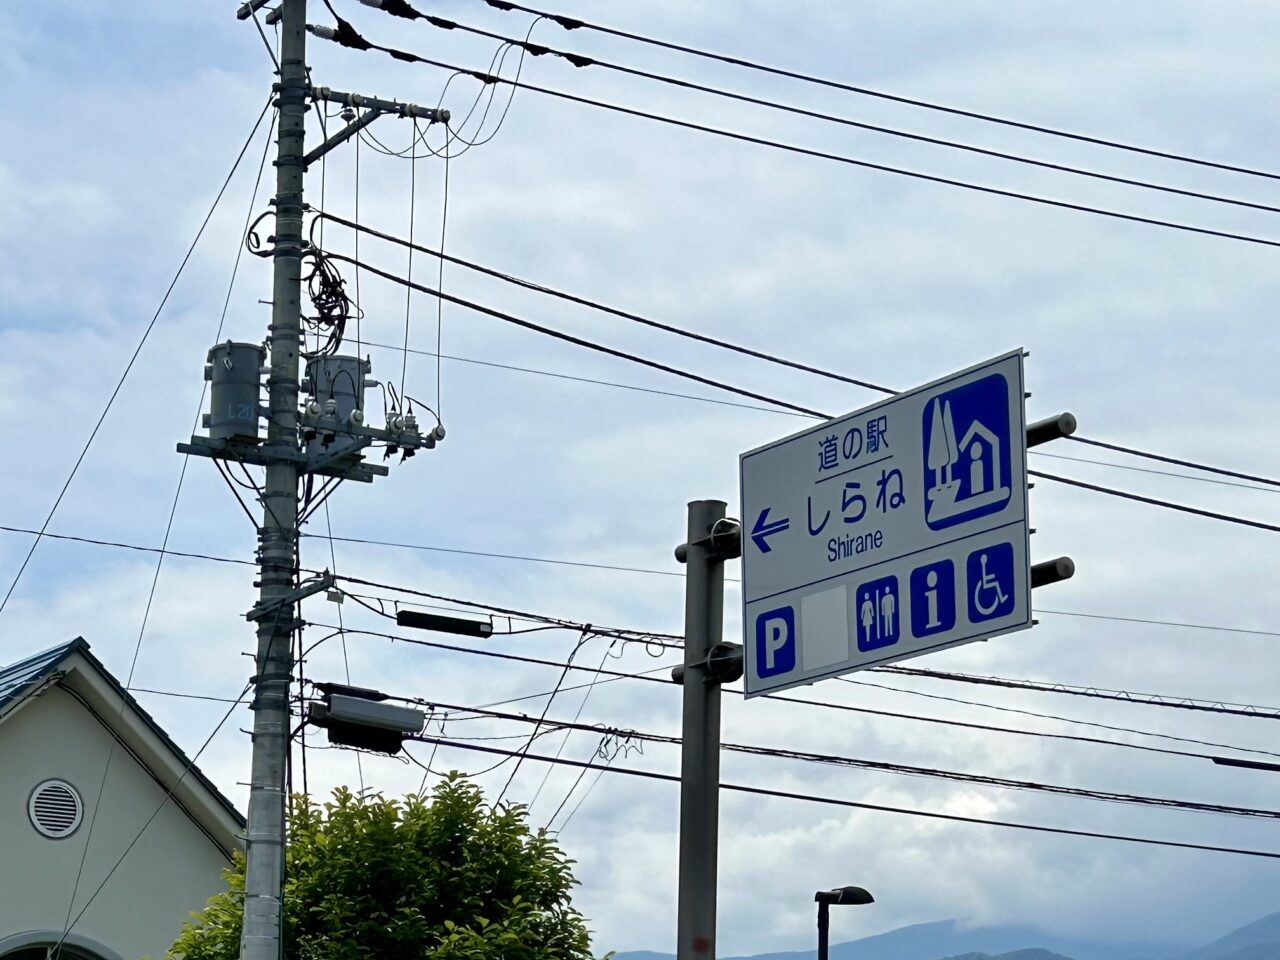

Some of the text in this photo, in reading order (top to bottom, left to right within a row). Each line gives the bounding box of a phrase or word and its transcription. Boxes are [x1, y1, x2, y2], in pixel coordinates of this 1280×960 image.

[818, 415, 889, 472] 道の駅
[808, 468, 906, 536] しらね
[827, 529, 883, 562] Shirane
